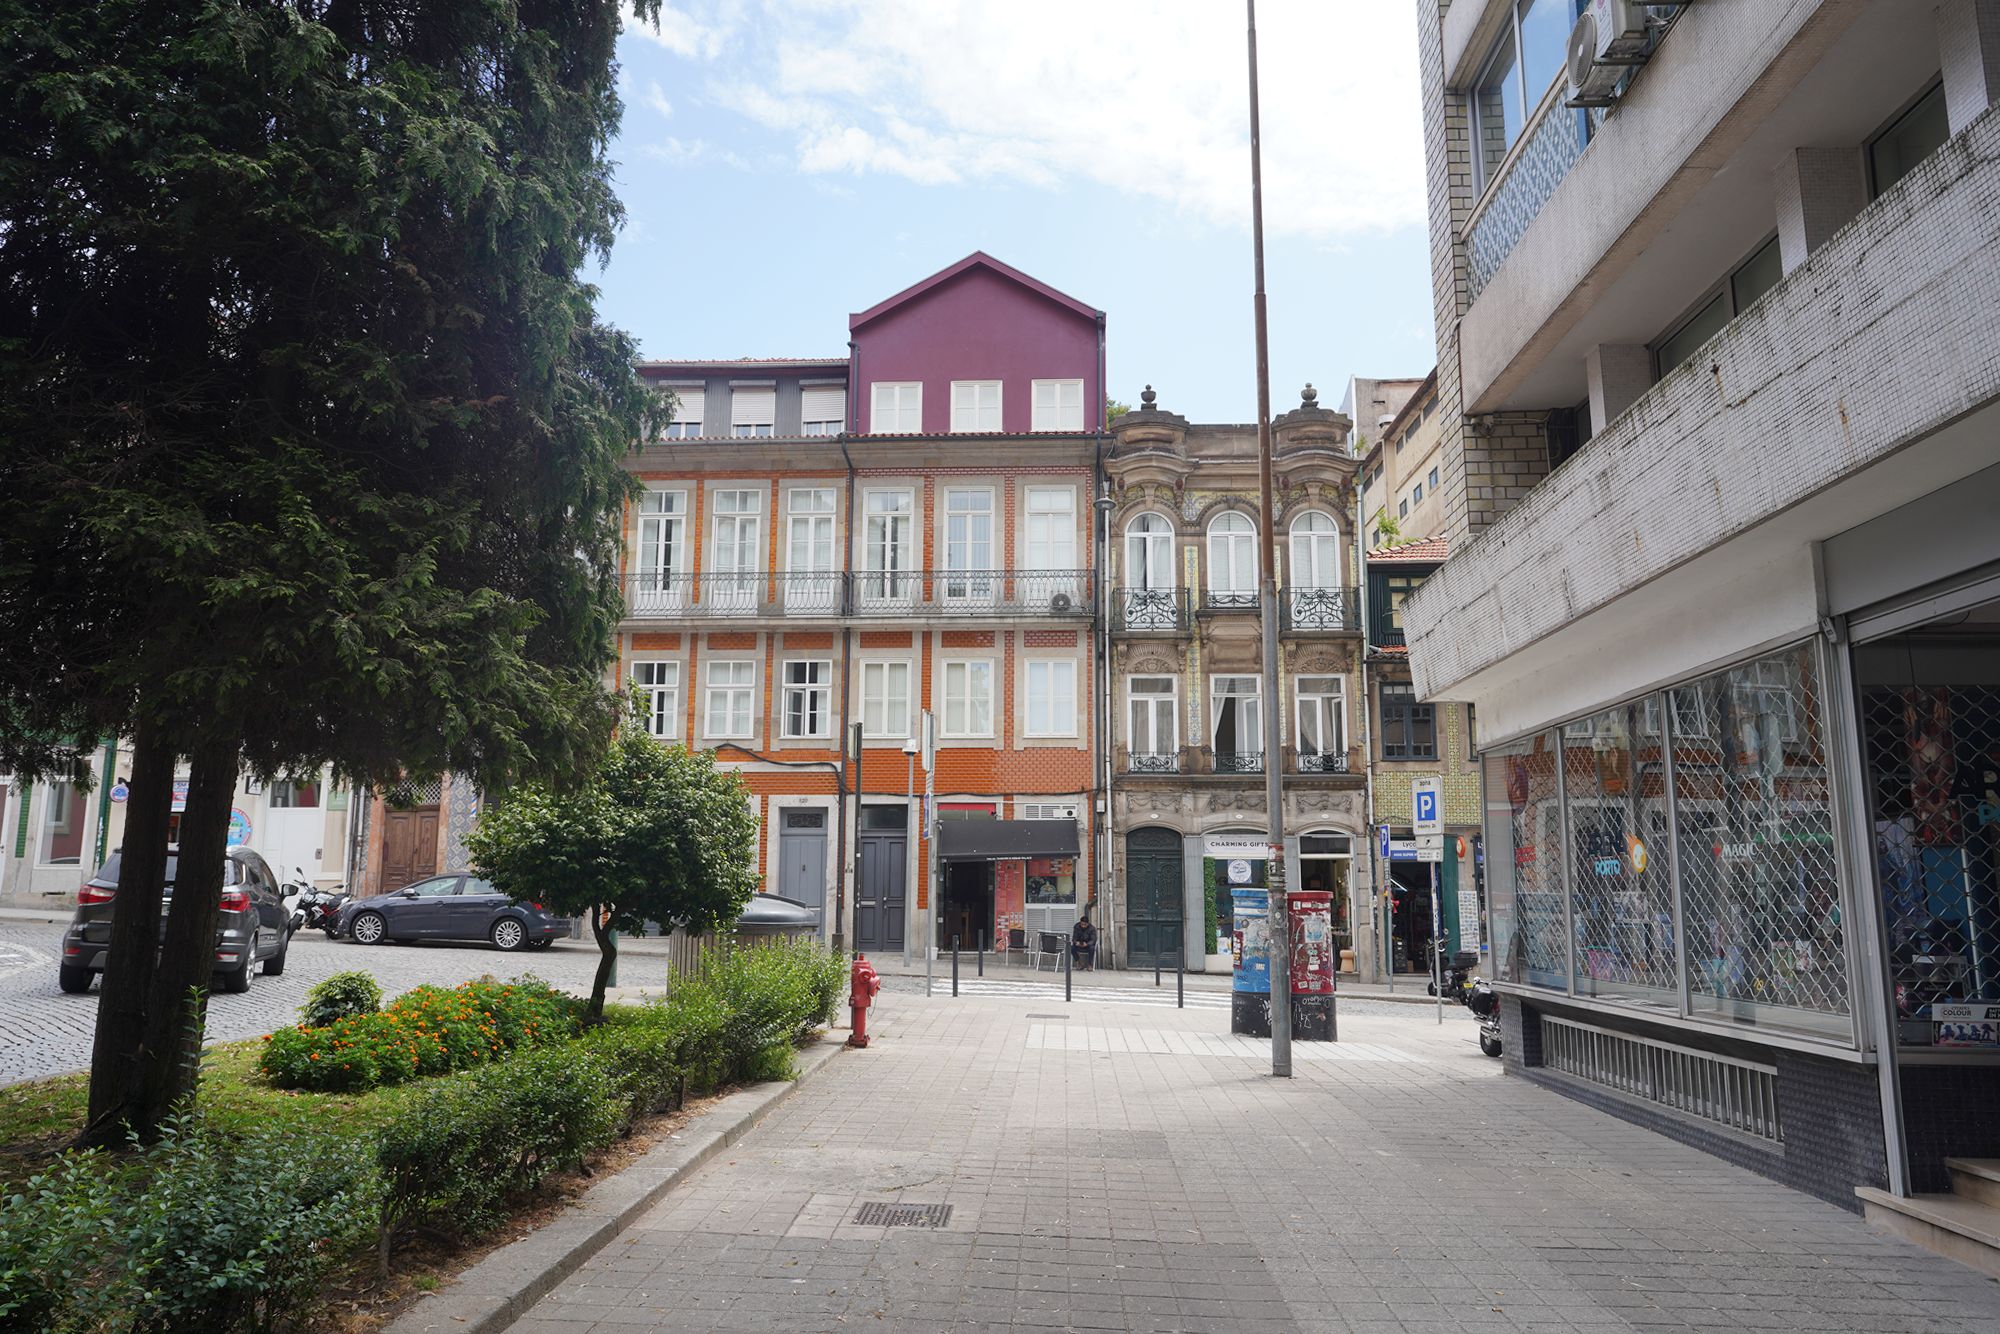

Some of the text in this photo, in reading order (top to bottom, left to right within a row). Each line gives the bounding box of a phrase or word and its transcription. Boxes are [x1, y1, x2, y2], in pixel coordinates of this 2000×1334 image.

[1420, 795, 1433, 819] P
[1210, 840, 1248, 848] CHARMING
[1381, 828, 1388, 856] P
[1721, 842, 1758, 858] MAGIC
[1595, 859, 1621, 876] PORTO
[1942, 1009, 1973, 1017] COLOUR
